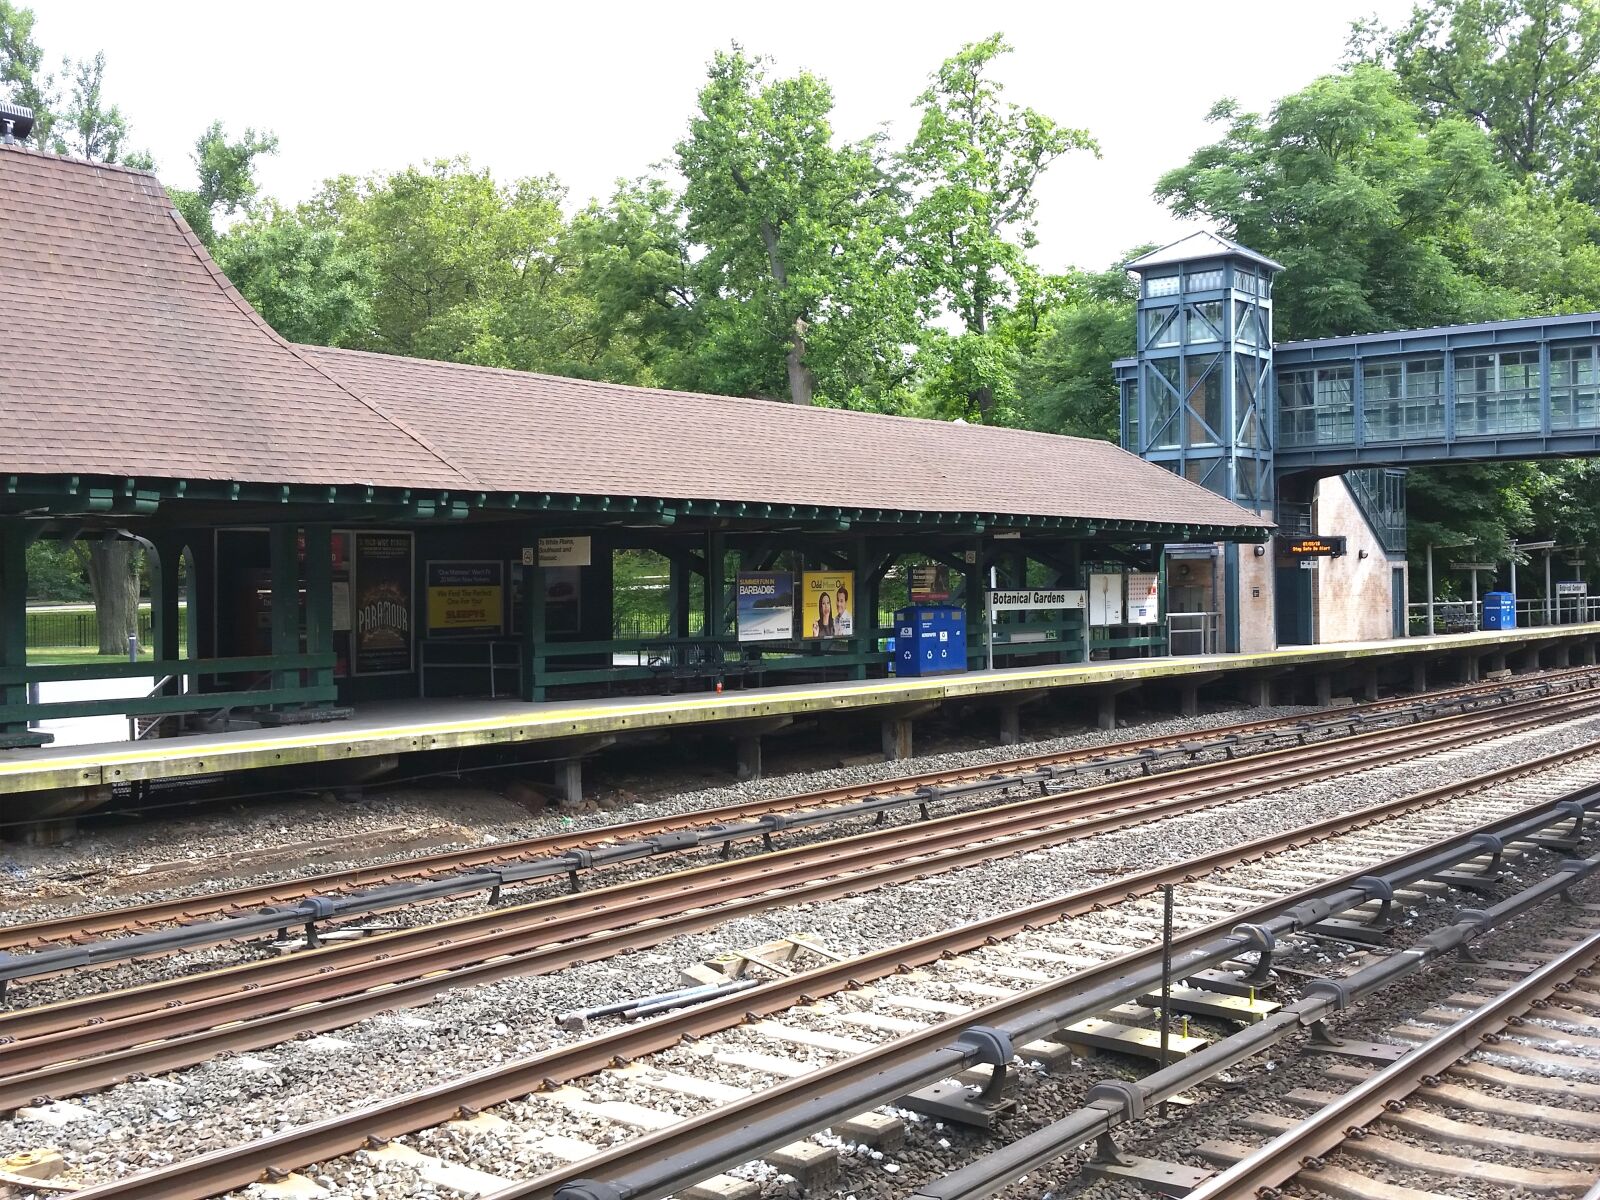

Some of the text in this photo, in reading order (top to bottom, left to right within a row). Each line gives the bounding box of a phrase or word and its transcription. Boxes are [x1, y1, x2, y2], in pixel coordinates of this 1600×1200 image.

[739, 585, 775, 595] BARBADOS
[811, 580, 823, 589] Odd
[992, 592, 1065, 605] Botanical Gardens
[358, 601, 408, 633] PARAMOUR
